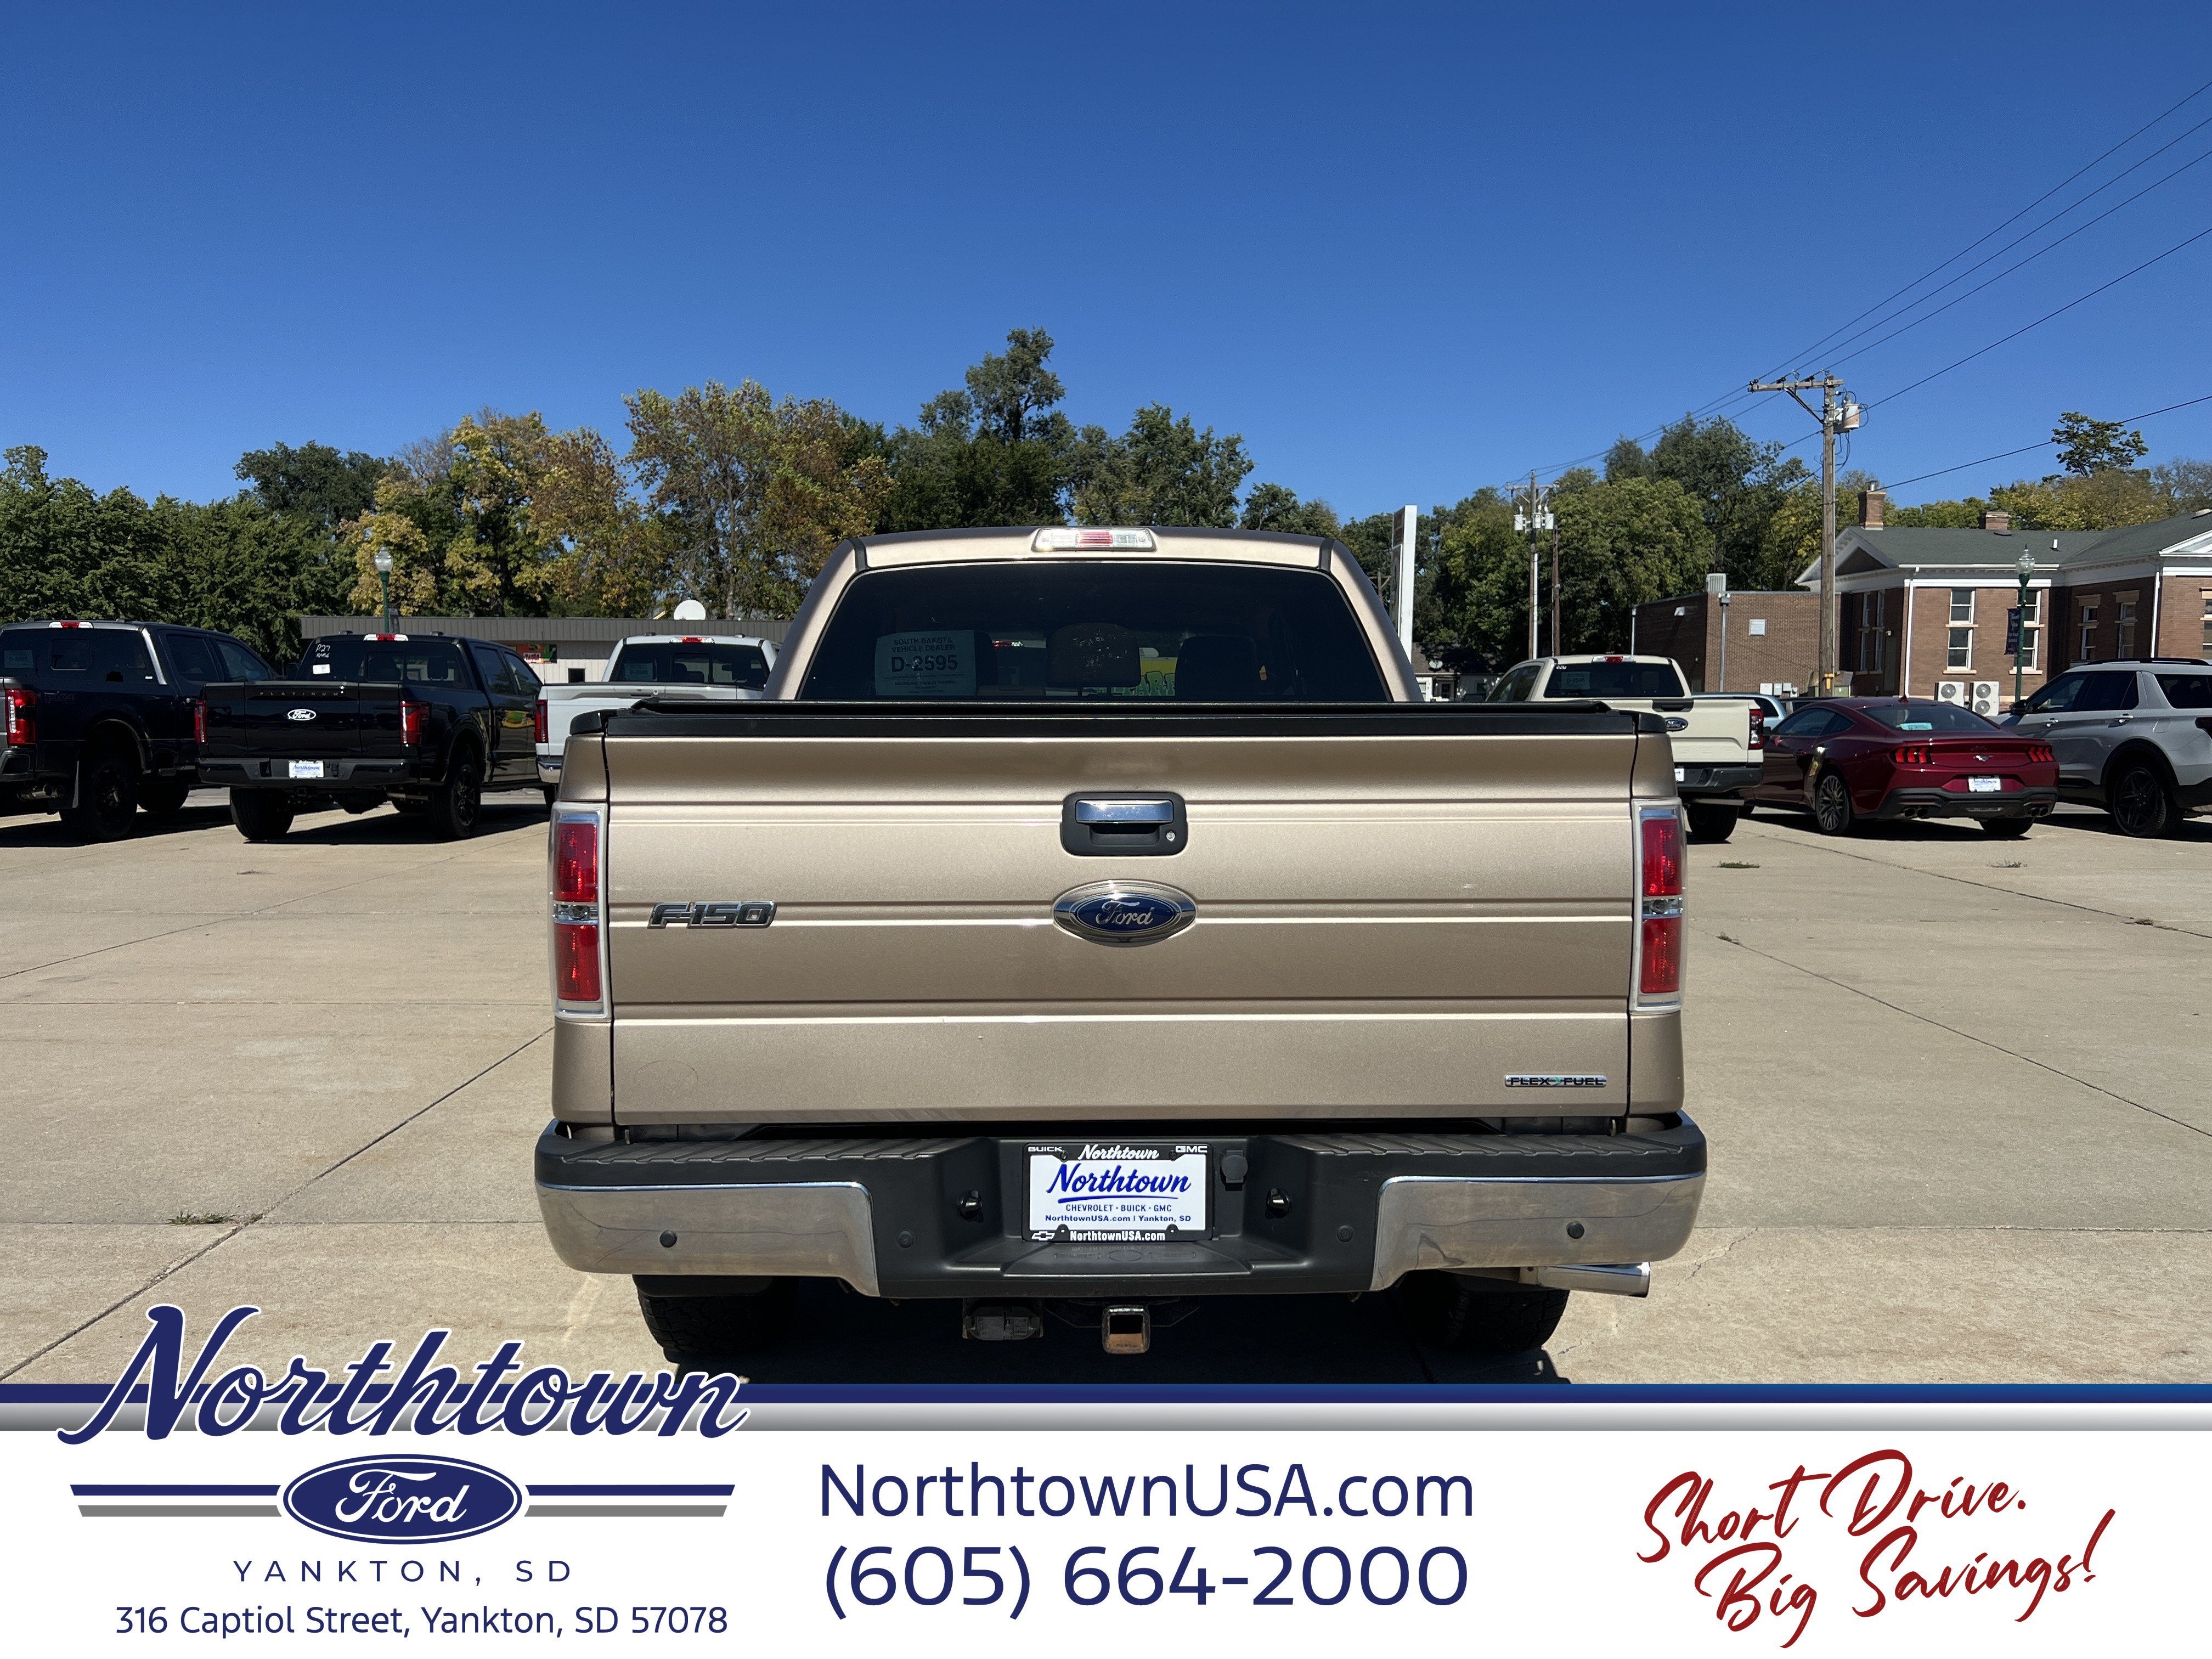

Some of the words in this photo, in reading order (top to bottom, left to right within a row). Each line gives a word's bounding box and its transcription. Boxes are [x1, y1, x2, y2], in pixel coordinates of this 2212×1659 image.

[894, 637, 919, 646] SOUTH
[891, 654, 958, 672] D-2595
[647, 900, 778, 929] F-150
[1095, 900, 1155, 926] Ford
[1510, 1077, 1550, 1086] FLEX
[1563, 1077, 1604, 1085] FUEL
[1077, 1144, 1159, 1160] Northtown
[1046, 1163, 1192, 1193] Northtown
[1138, 1215, 1176, 1223] Yankton,
[1070, 1231, 1165, 1241] NorthtownUSA.com
